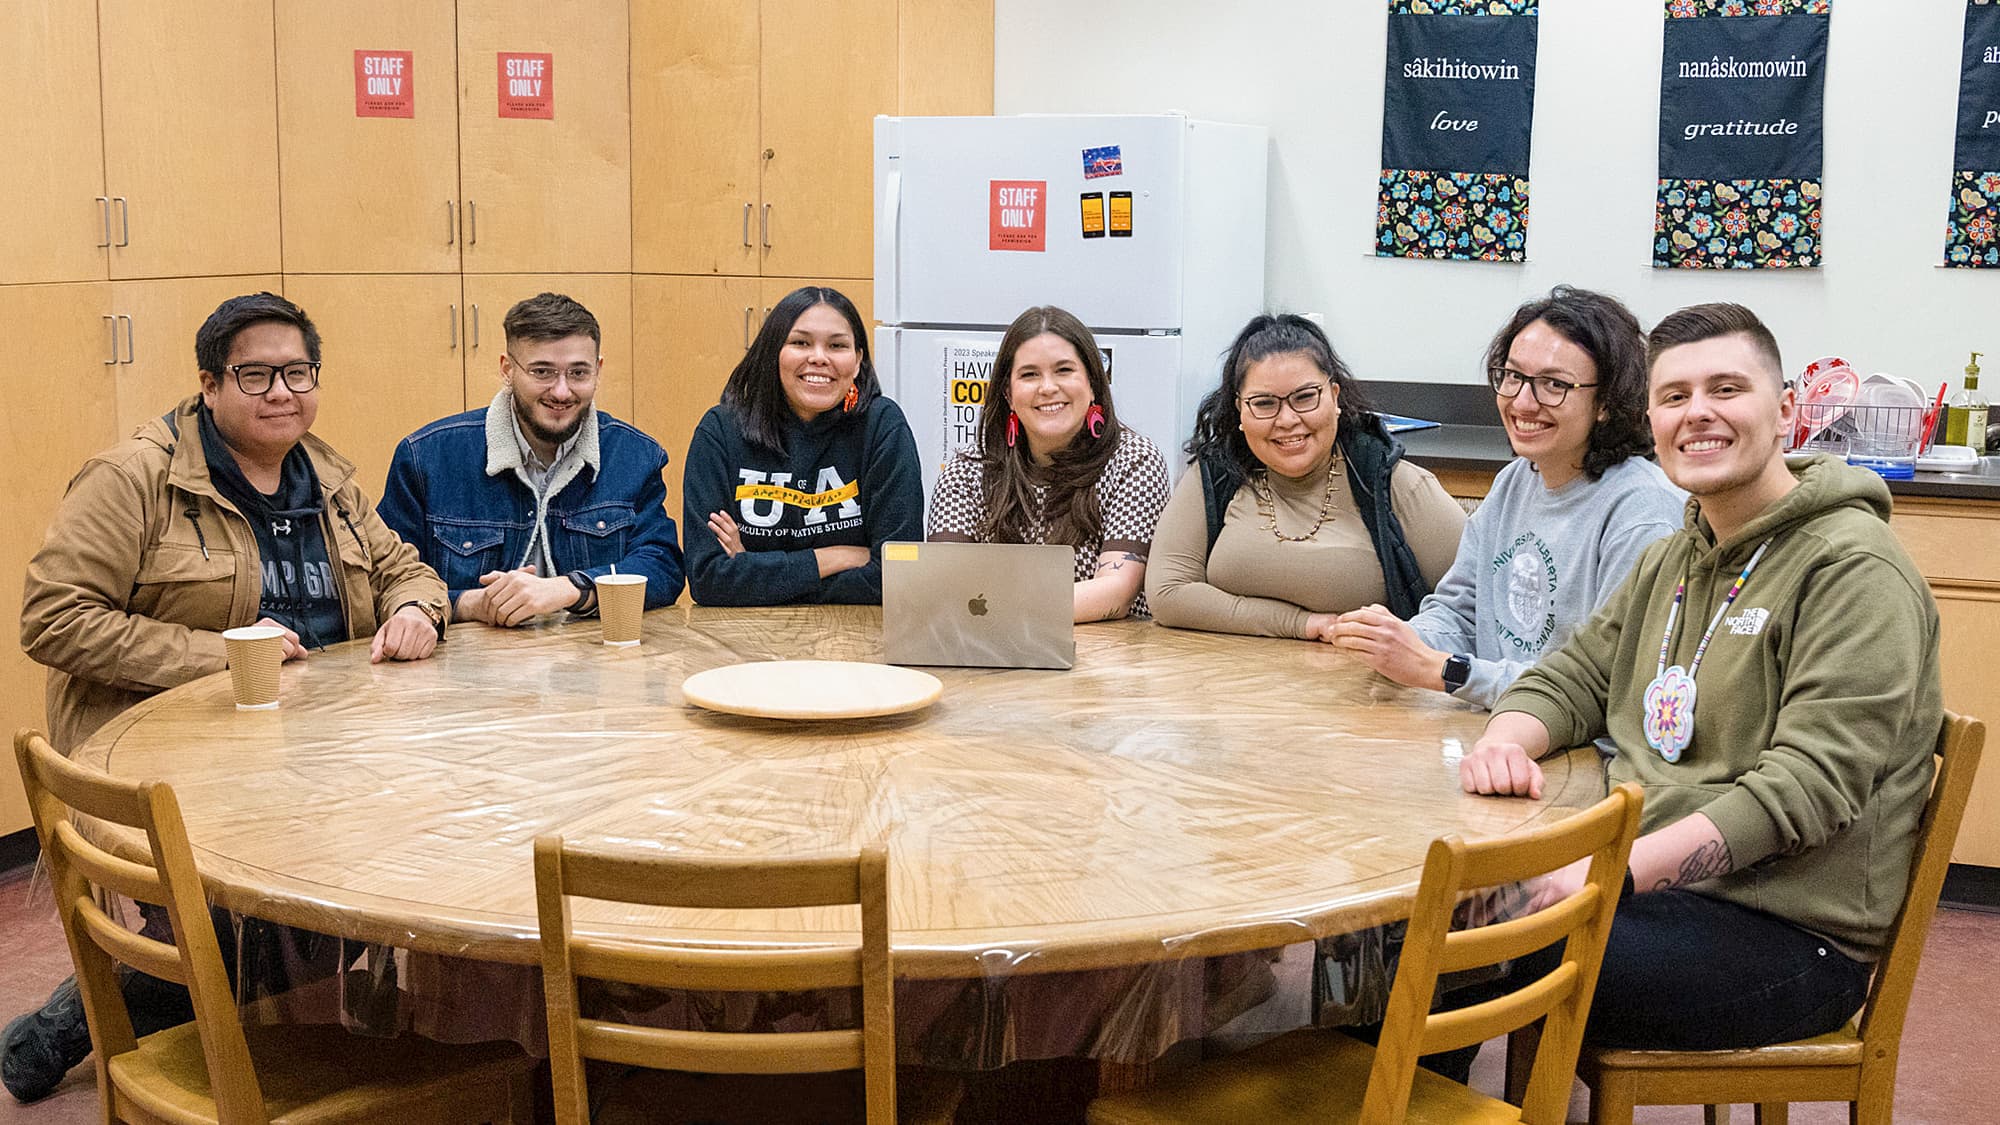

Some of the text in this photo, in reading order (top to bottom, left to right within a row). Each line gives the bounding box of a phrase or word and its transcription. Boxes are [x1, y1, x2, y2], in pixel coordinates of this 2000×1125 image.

[364, 57, 404, 75] STAFF
[506, 59, 544, 78] STAFF
[1403, 57, 1520, 81] sâkihitowin
[1678, 54, 1807, 80] nanâskomowin
[367, 77, 401, 96] ONLY
[509, 79, 542, 97] ONLY
[1430, 110, 1479, 132] love
[1684, 118, 1798, 141] gratitude
[999, 187, 1038, 207] STAFF
[1001, 208, 1035, 228] ONLY
[954, 348, 970, 357] 2023
[954, 405, 975, 423] TO
[797, 479, 807, 490] OF
[737, 518, 863, 538] FACULTY OF NATIVE STUDIES
[1534, 538, 1557, 593] ALBERTA
[1724, 616, 1757, 627] NORTH
[1743, 608, 1758, 617] THE
[1730, 625, 1753, 635] FACE
